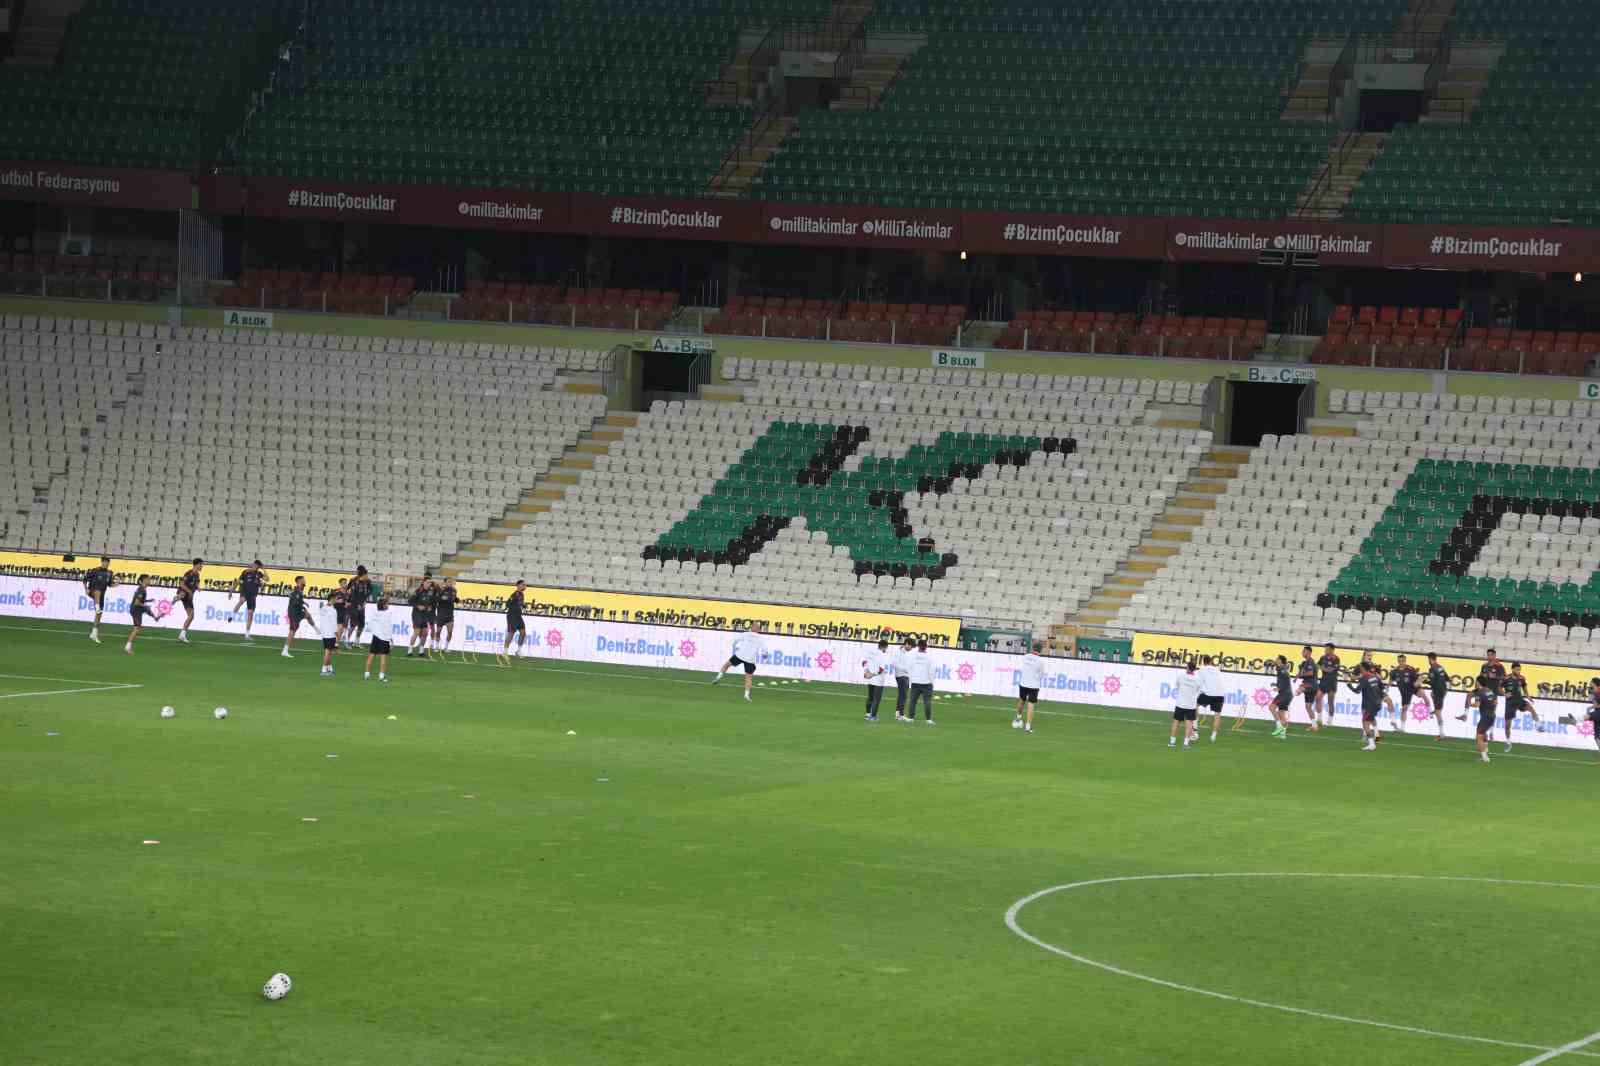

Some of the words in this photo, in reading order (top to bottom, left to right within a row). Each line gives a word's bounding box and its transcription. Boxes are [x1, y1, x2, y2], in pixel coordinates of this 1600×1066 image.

[0, 170, 33, 187] utbol
[37, 171, 120, 194] Federasyonu
[287, 189, 397, 212] #BizimÇocuklar
[611, 207, 722, 228] #BizimÇocuklar
[1003, 223, 1122, 245] #BizimÇocuklar
[1430, 236, 1563, 257] #BizimÇocuklar
[230, 311, 240, 324] A
[937, 352, 948, 366] B
[596, 636, 674, 657] DenizBank
